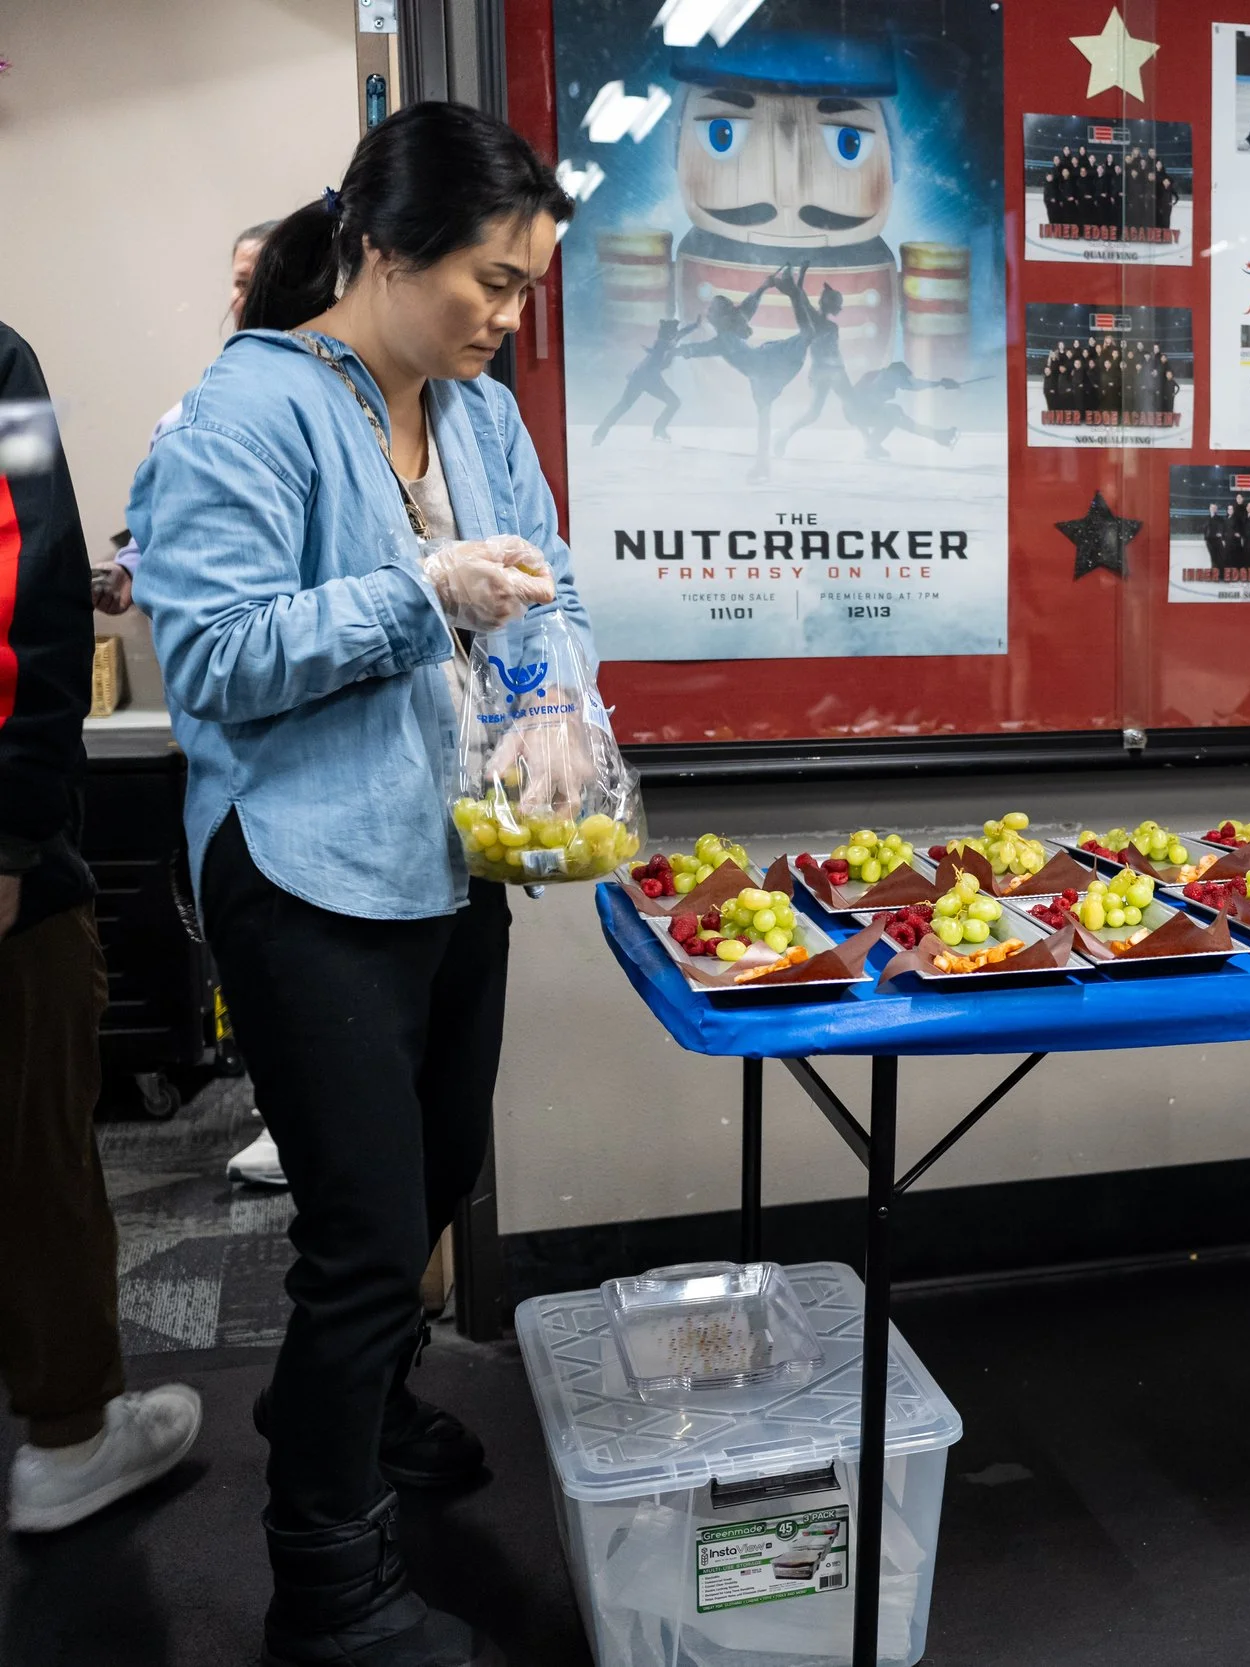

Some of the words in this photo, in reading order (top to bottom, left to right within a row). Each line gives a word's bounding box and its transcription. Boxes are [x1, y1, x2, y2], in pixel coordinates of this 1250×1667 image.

[776, 513, 818, 525] THE
[614, 529, 969, 560] NUTCRACKER
[658, 567, 804, 580] FANTASY
[828, 566, 861, 579] ON
[885, 566, 931, 579] ICE
[682, 593, 726, 602] TICKETS
[730, 593, 744, 601] ON
[749, 593, 776, 601] SALE
[820, 592, 892, 601] PREMIERING
[899, 592, 911, 600] AT
[918, 592, 940, 600] 7PM
[529, 704, 575, 716] EVERYON
[803, 1514, 810, 1523] 3
[812, 1510, 835, 1521] PACK
[703, 1526, 761, 1540] Greenmade
[779, 1522, 792, 1534] 45
[709, 1543, 765, 1558] InstaView
